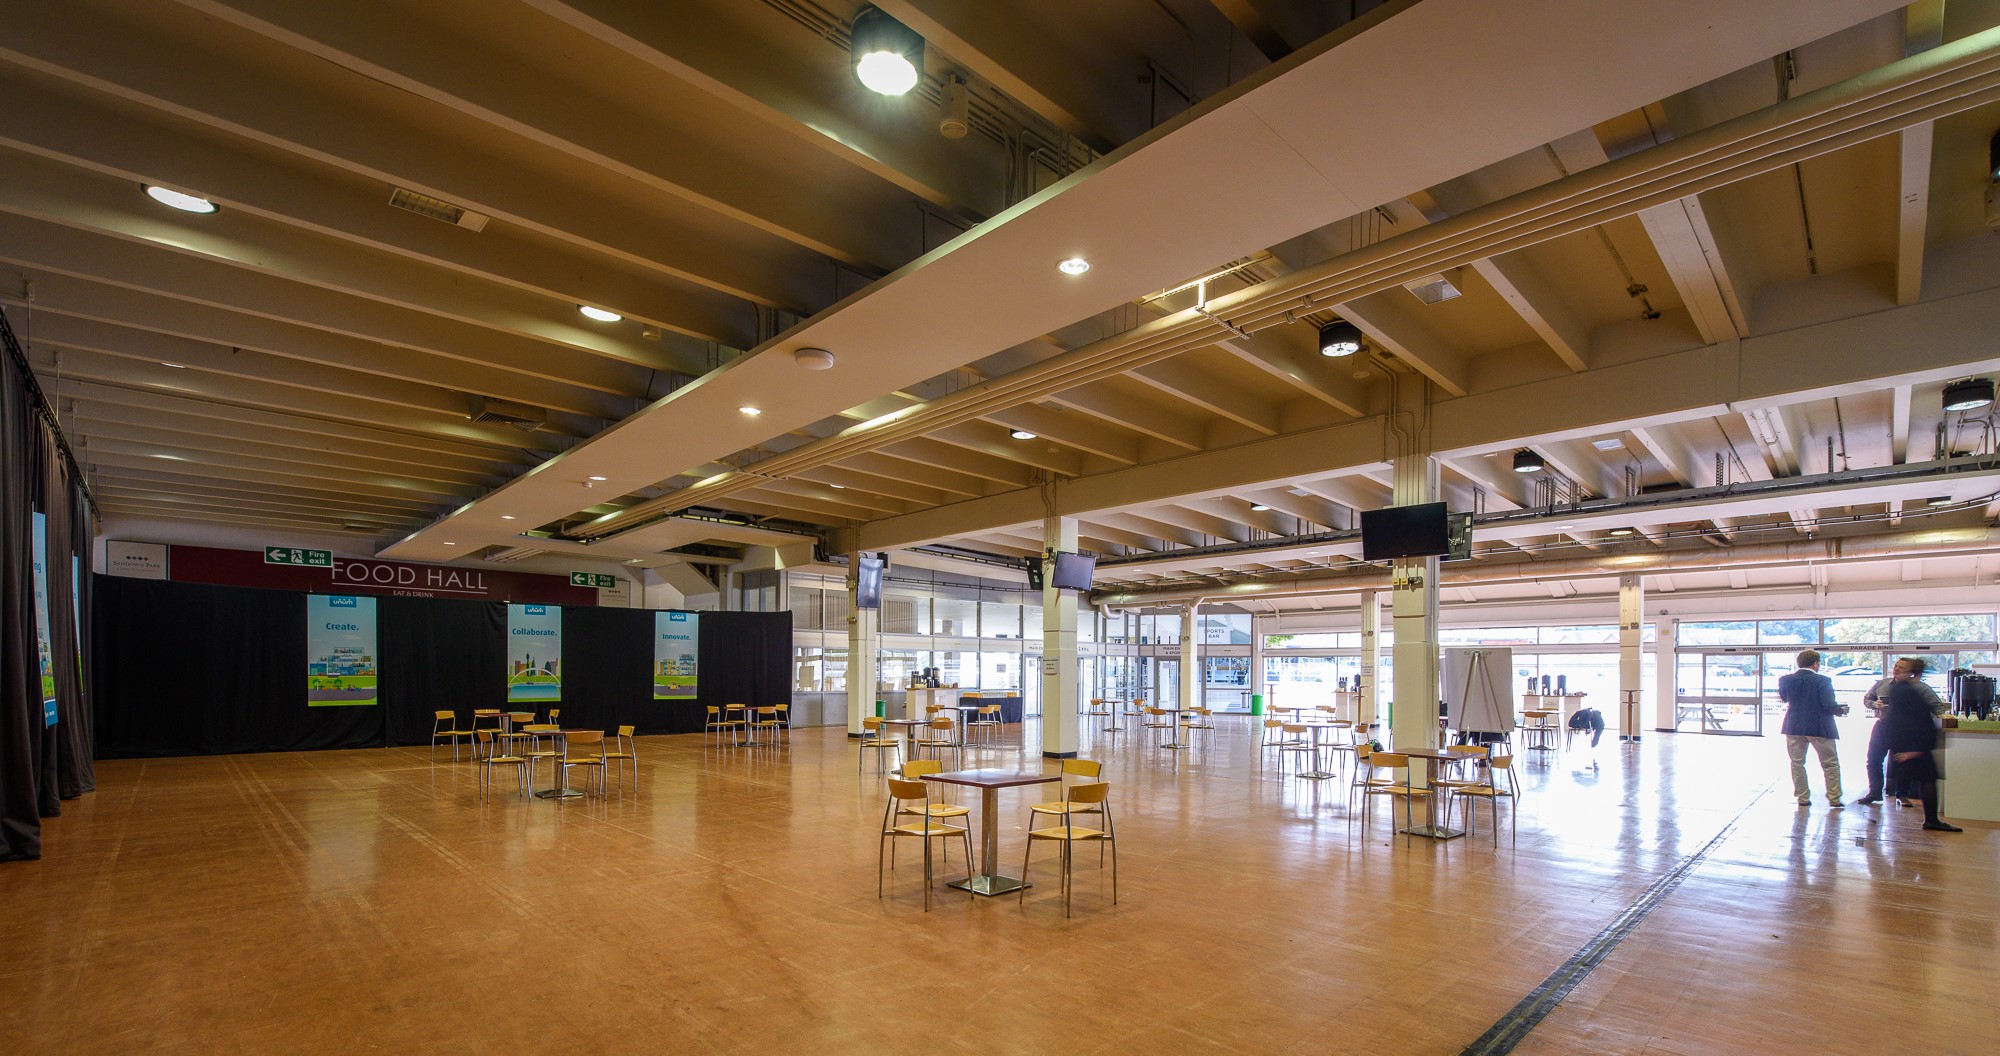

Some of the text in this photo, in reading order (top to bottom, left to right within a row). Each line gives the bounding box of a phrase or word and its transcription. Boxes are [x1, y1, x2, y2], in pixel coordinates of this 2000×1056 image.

[308, 550, 325, 559] Fire
[308, 557, 325, 565] exit
[331, 561, 488, 590] FOOD HALL
[412, 590, 434, 598] DRINK
[325, 622, 360, 631] Create.
[512, 628, 558, 636] Collaborate.
[662, 633, 692, 641] Innovate.
